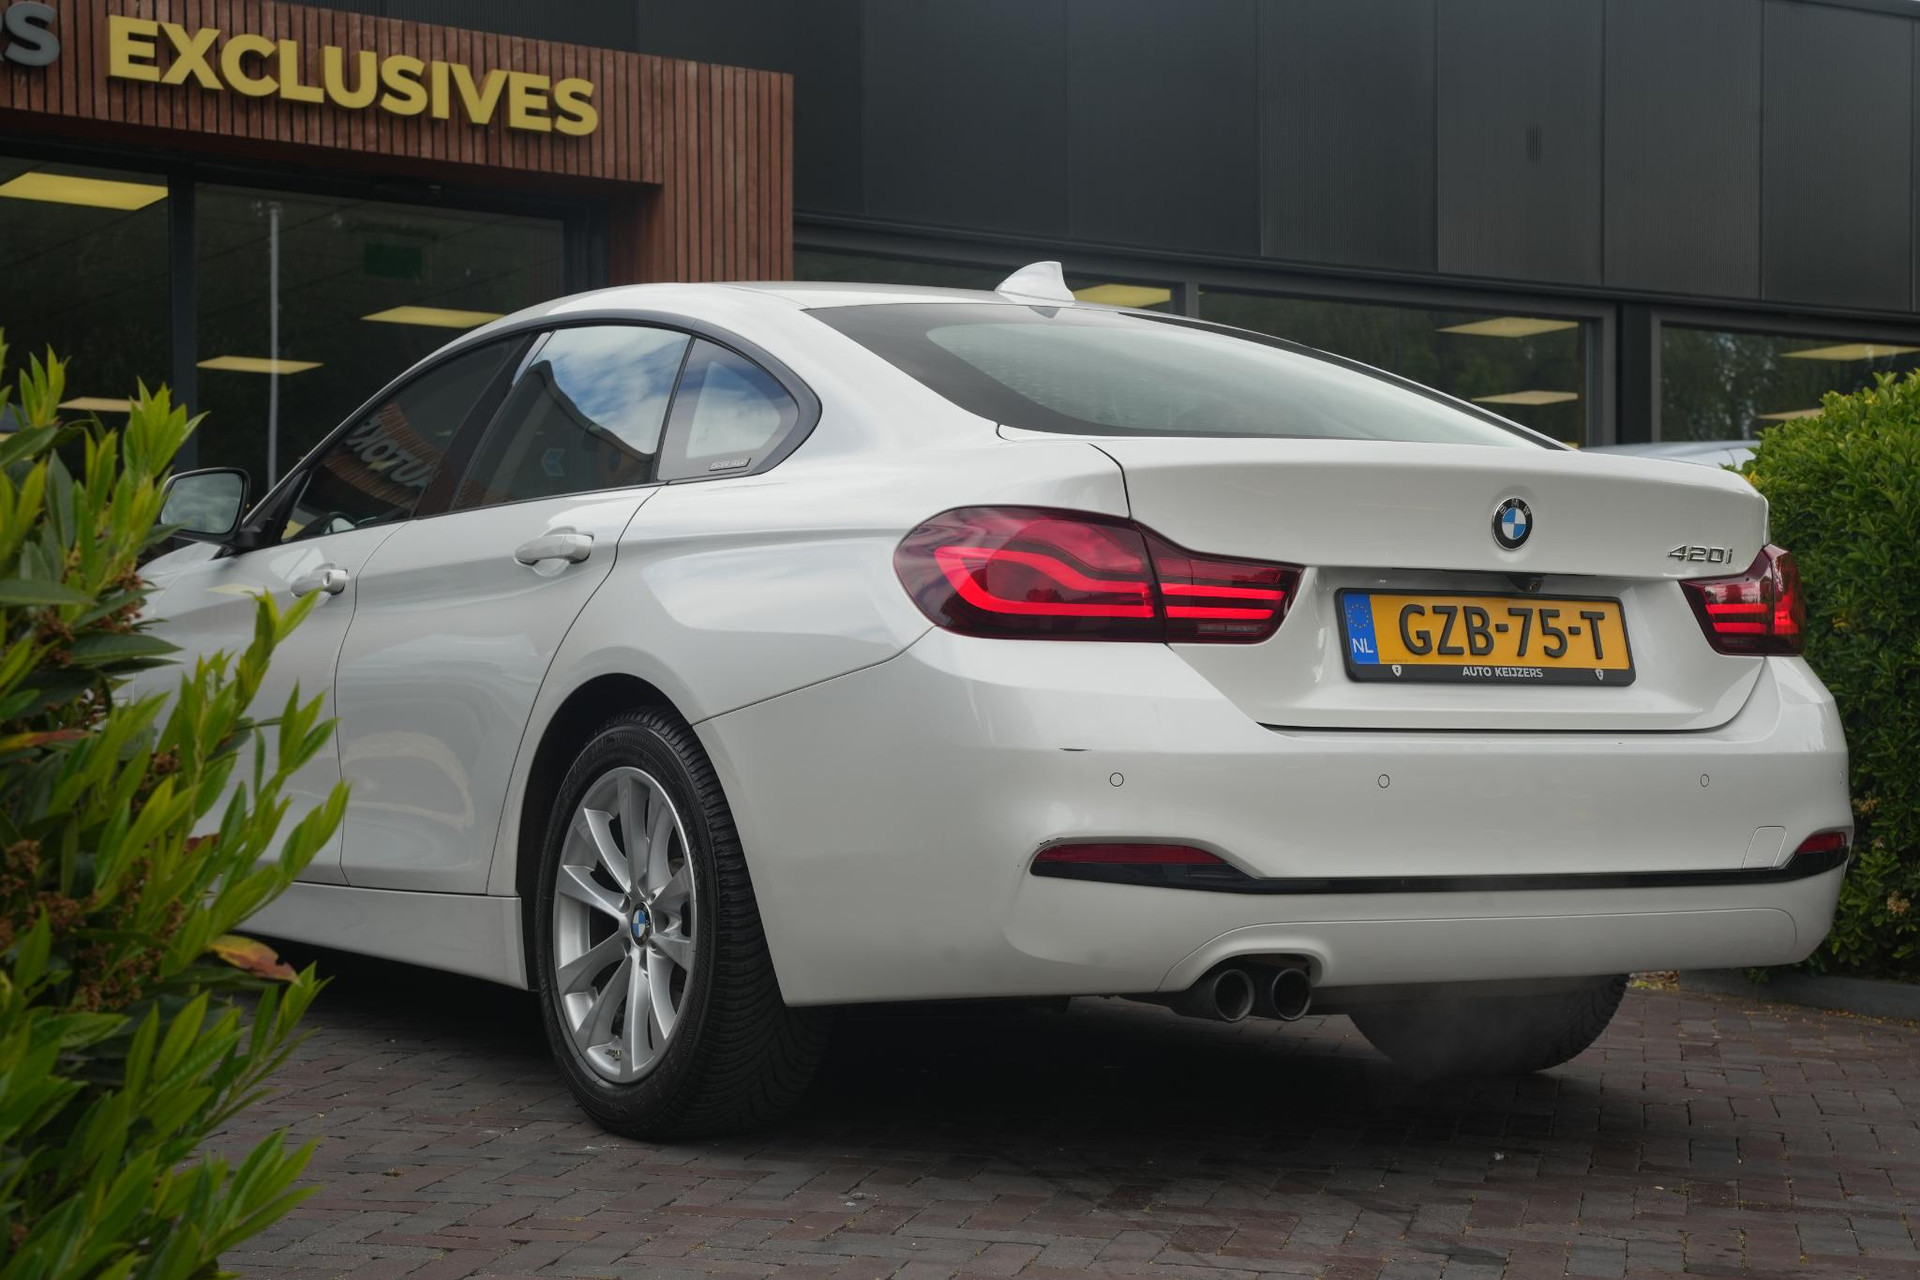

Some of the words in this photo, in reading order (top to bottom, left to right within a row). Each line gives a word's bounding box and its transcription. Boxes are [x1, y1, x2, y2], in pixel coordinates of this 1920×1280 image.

[0, 1, 60, 66] S
[108, 15, 598, 136] EXCLUSIVES
[1667, 544, 1733, 565] 420i
[1399, 603, 1606, 660] GZB-75-T
[1352, 638, 1374, 653] NL
[1462, 666, 1491, 677] AUTO
[1495, 667, 1543, 678] KEIJZERS
